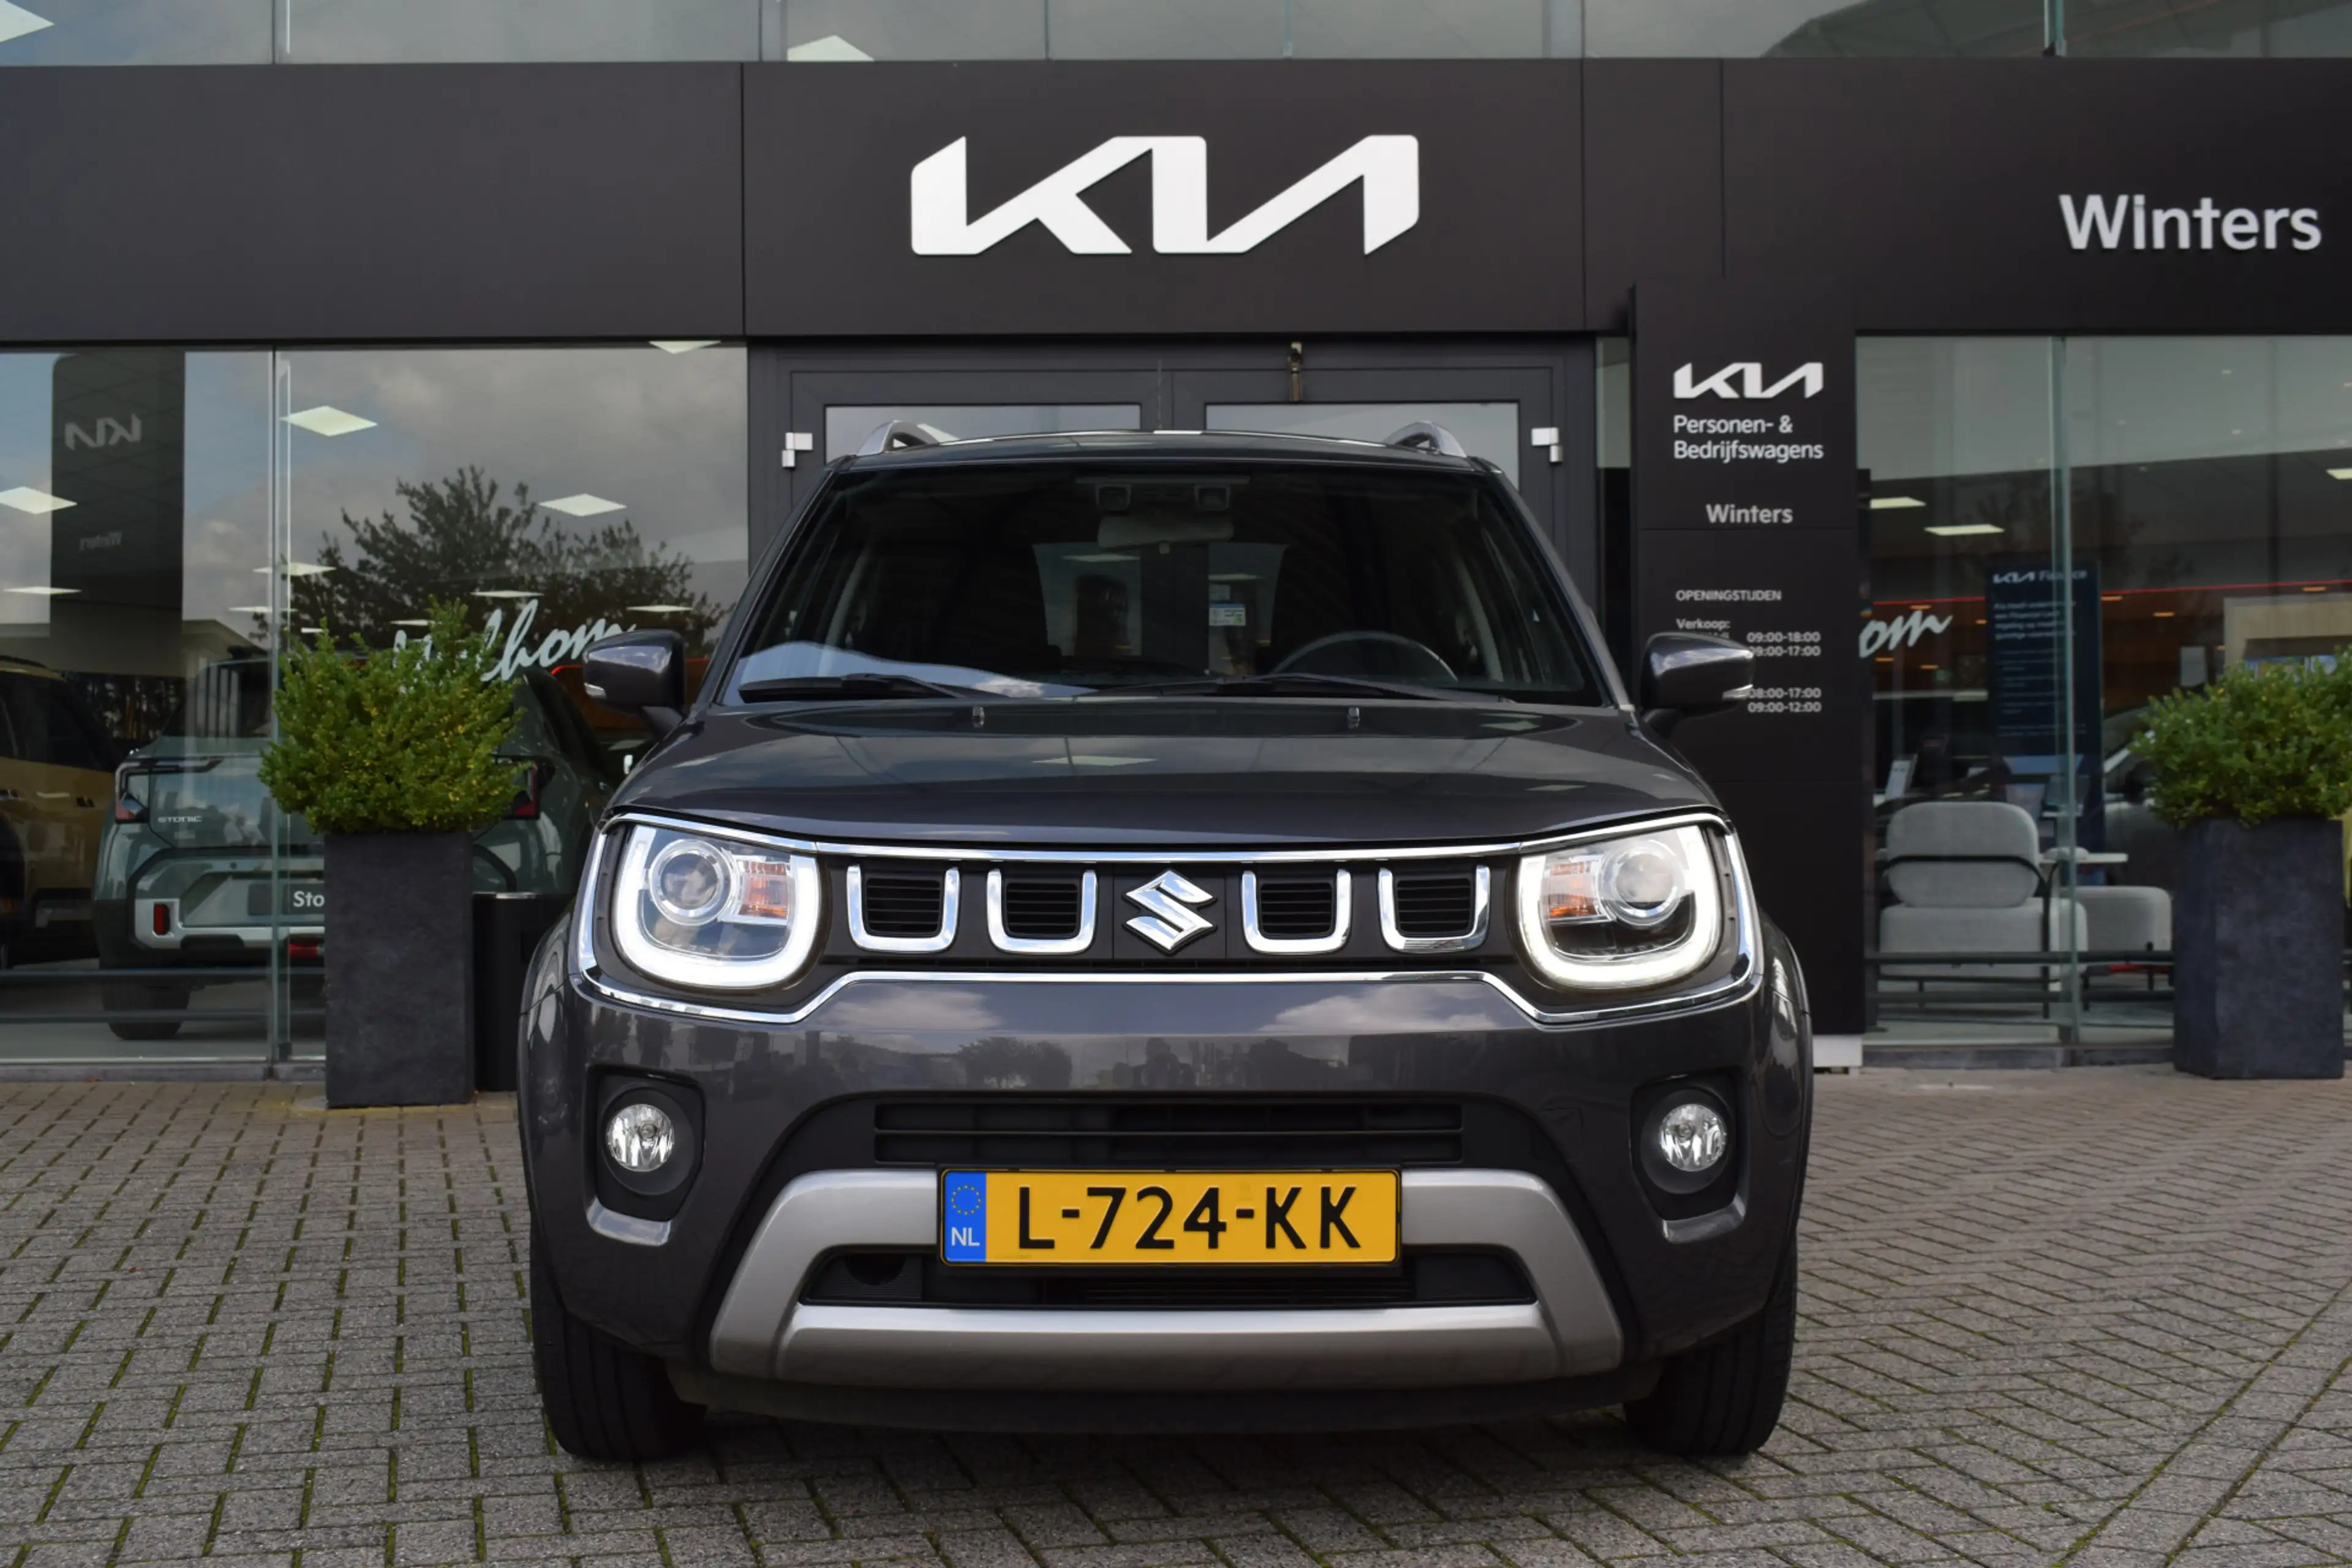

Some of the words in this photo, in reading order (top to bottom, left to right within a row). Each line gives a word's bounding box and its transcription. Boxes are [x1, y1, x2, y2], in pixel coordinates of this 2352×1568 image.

[911, 135, 1419, 255] KIA
[2059, 194, 2322, 251] Winters
[1673, 362, 1823, 399] KIA
[1673, 414, 1774, 434] Personen-
[1778, 414, 1794, 434] &
[1673, 439, 1824, 464] Bedrijfswagens
[1705, 503, 1794, 524] Winters
[1676, 618, 1731, 631] Verkoop:
[1746, 631, 1822, 643] 09:00-18:00
[1747, 702, 1823, 712] 09:00-12:00
[1018, 1185, 1362, 1250] L-724-KK
[951, 1227, 981, 1247] NL
